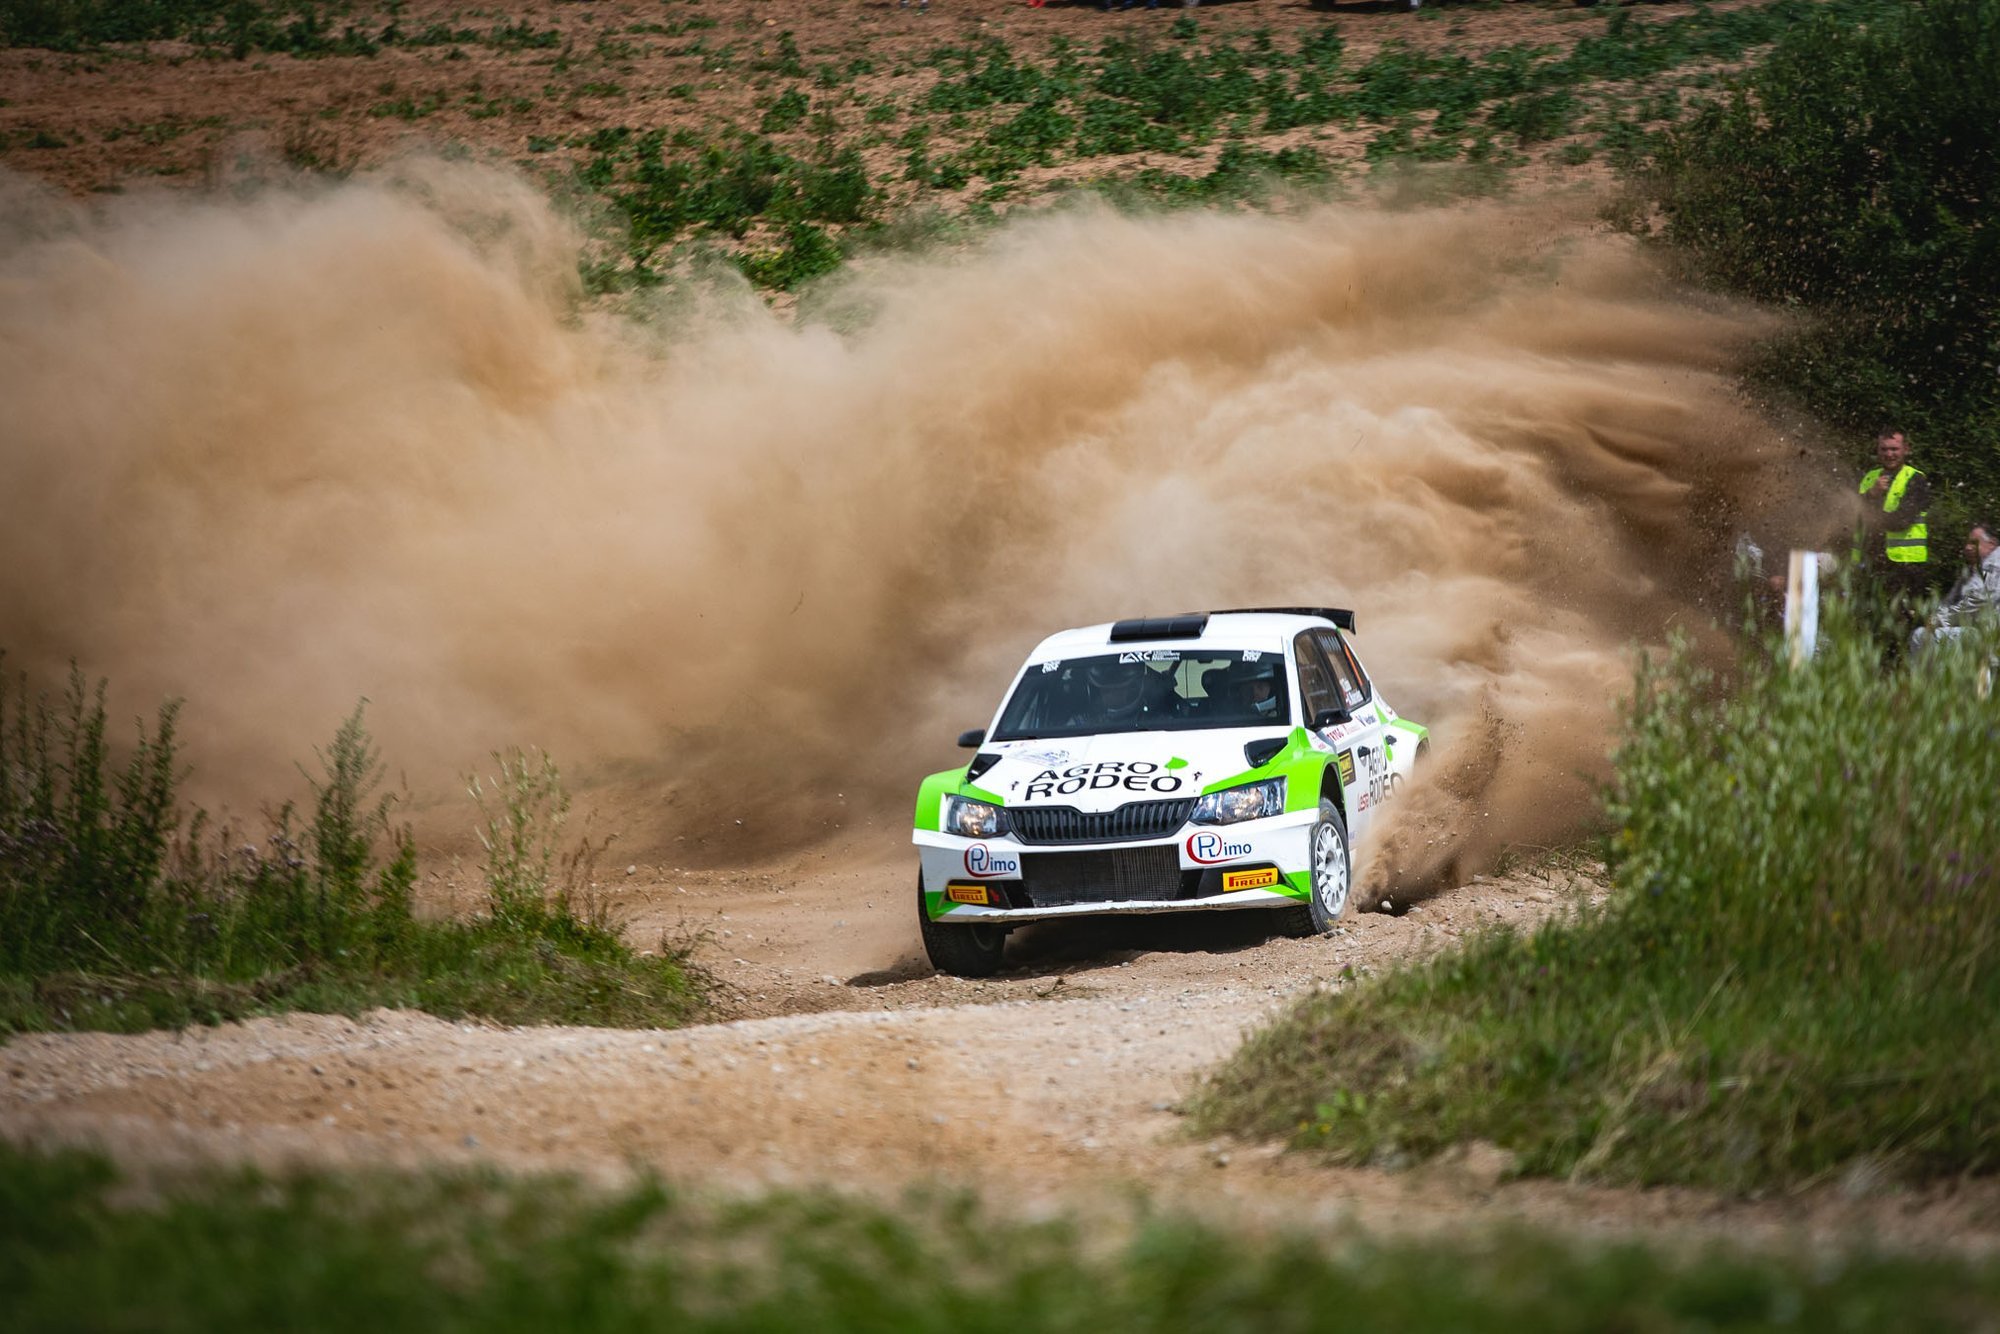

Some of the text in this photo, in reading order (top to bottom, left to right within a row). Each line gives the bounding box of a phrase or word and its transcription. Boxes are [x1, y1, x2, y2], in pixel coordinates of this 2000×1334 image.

[1030, 761, 1158, 783] AGRO
[1025, 774, 1182, 801] RODEO
[1229, 872, 1272, 887] PIRELLI
[952, 888, 984, 901] PIRELLI
